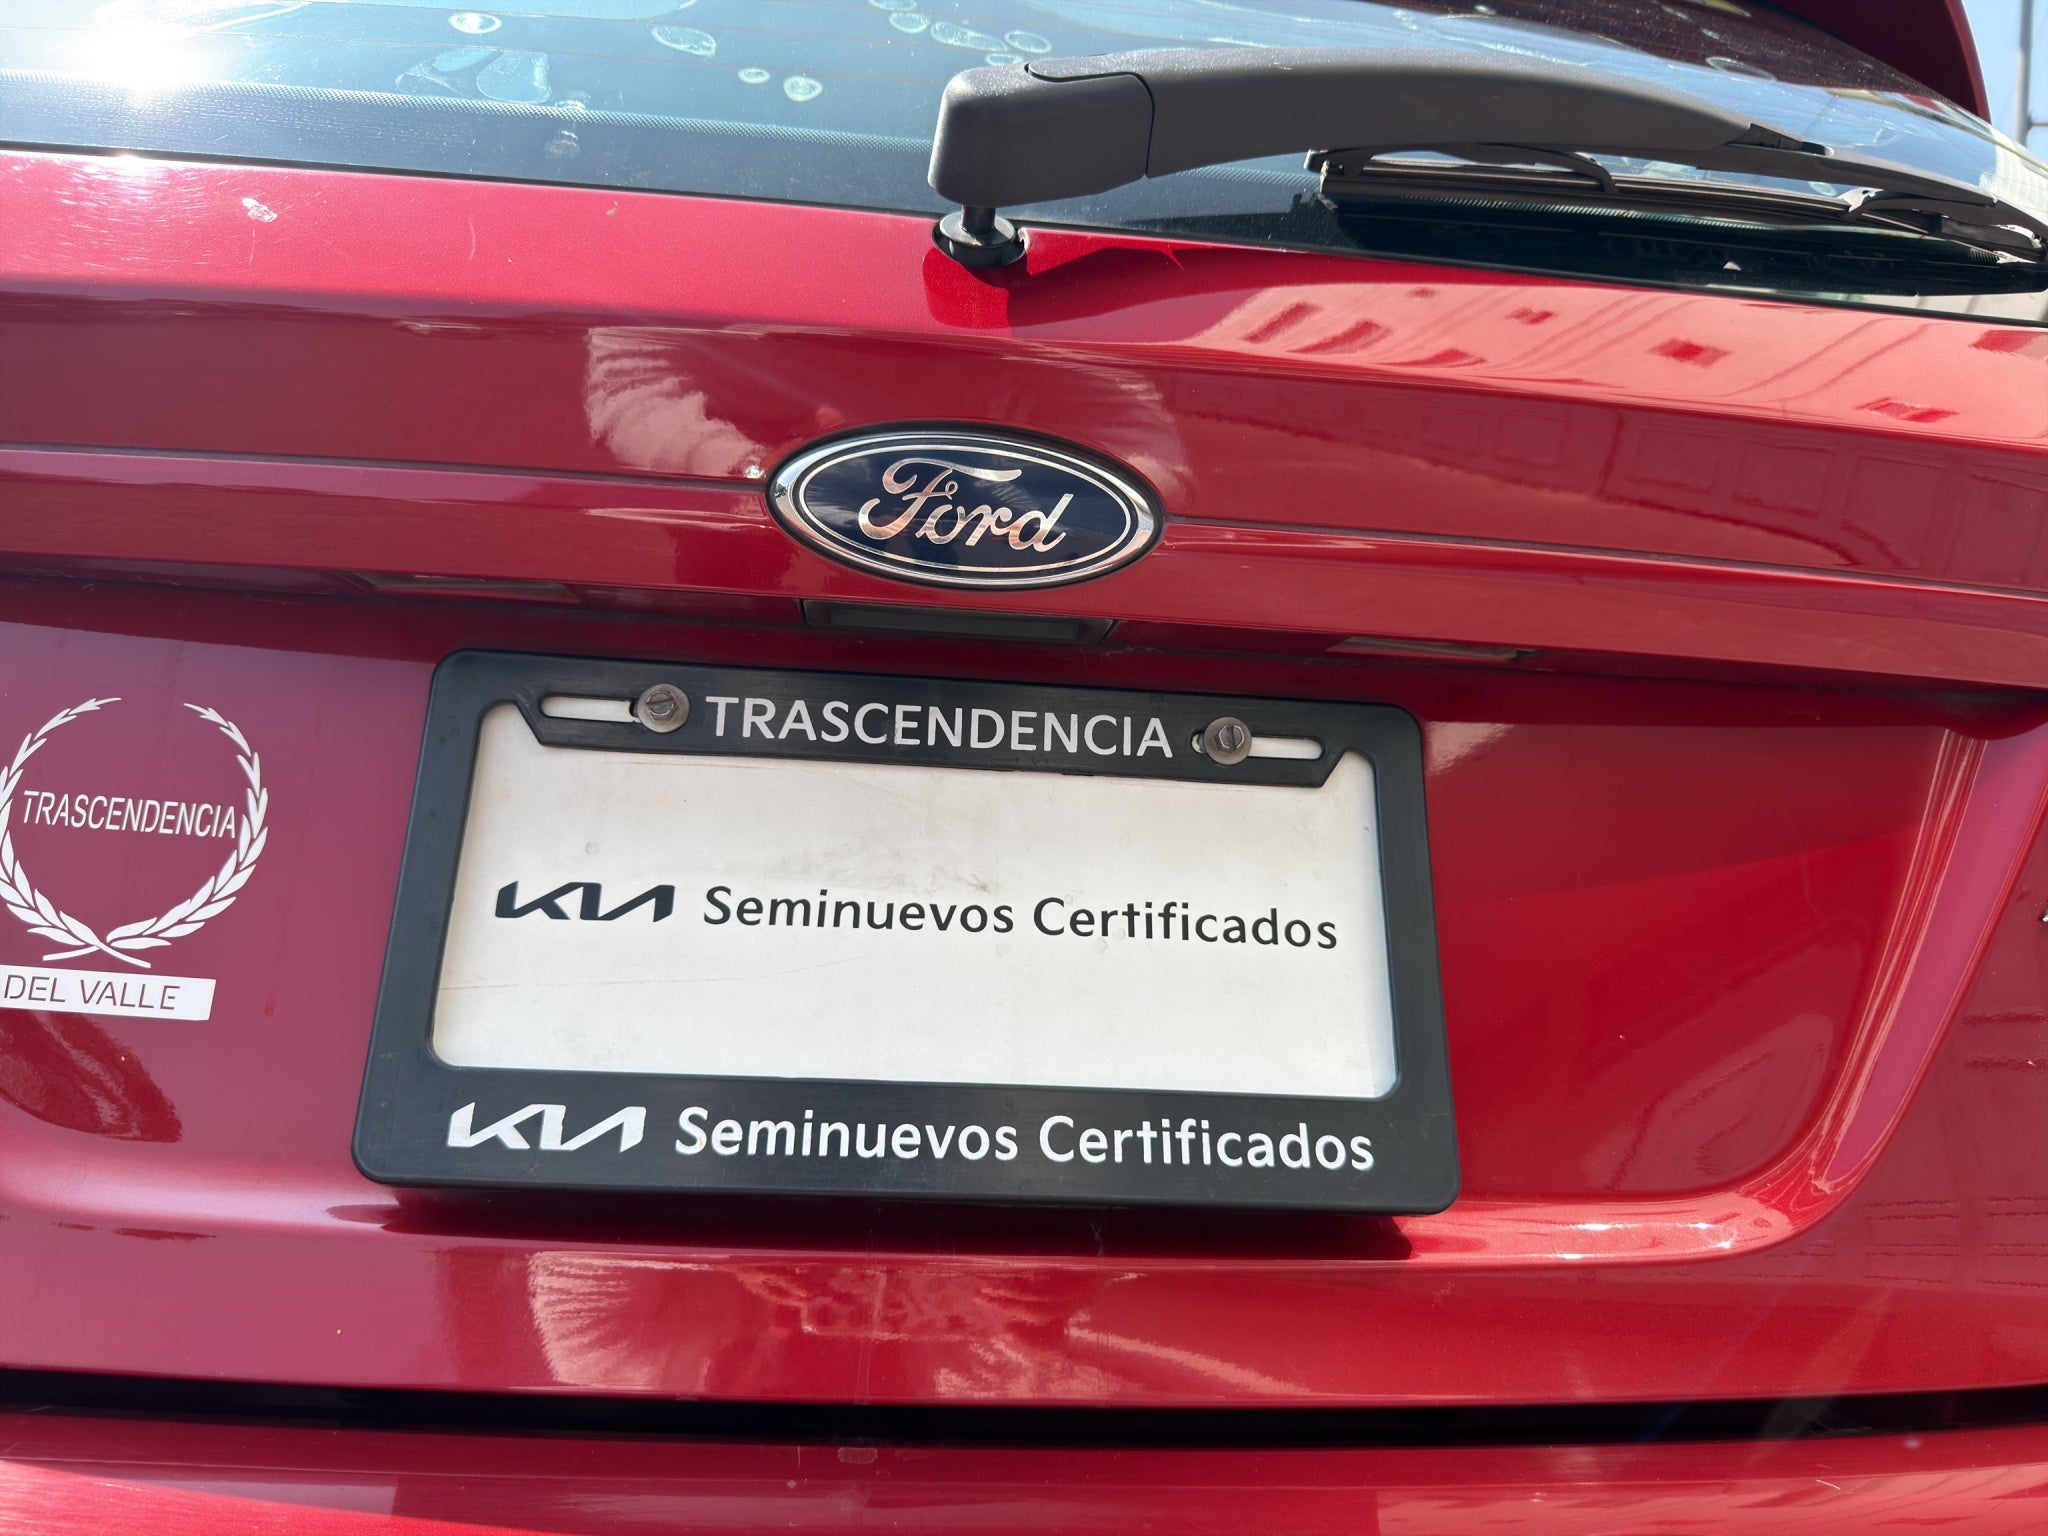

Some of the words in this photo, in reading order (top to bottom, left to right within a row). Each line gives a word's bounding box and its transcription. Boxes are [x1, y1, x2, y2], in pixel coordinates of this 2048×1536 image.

[857, 457, 1074, 553] Ford
[705, 695, 1174, 759] TRASCENDENCIA
[23, 789, 236, 839] TRASCENDENCIA
[703, 885, 1014, 934] Seminuevos
[1033, 896, 1338, 950] Certificados
[4, 973, 66, 1005] DEL
[80, 978, 181, 1010] VALLE
[674, 1105, 1018, 1163] Seminuevos
[1038, 1114, 1376, 1173] Certificados
